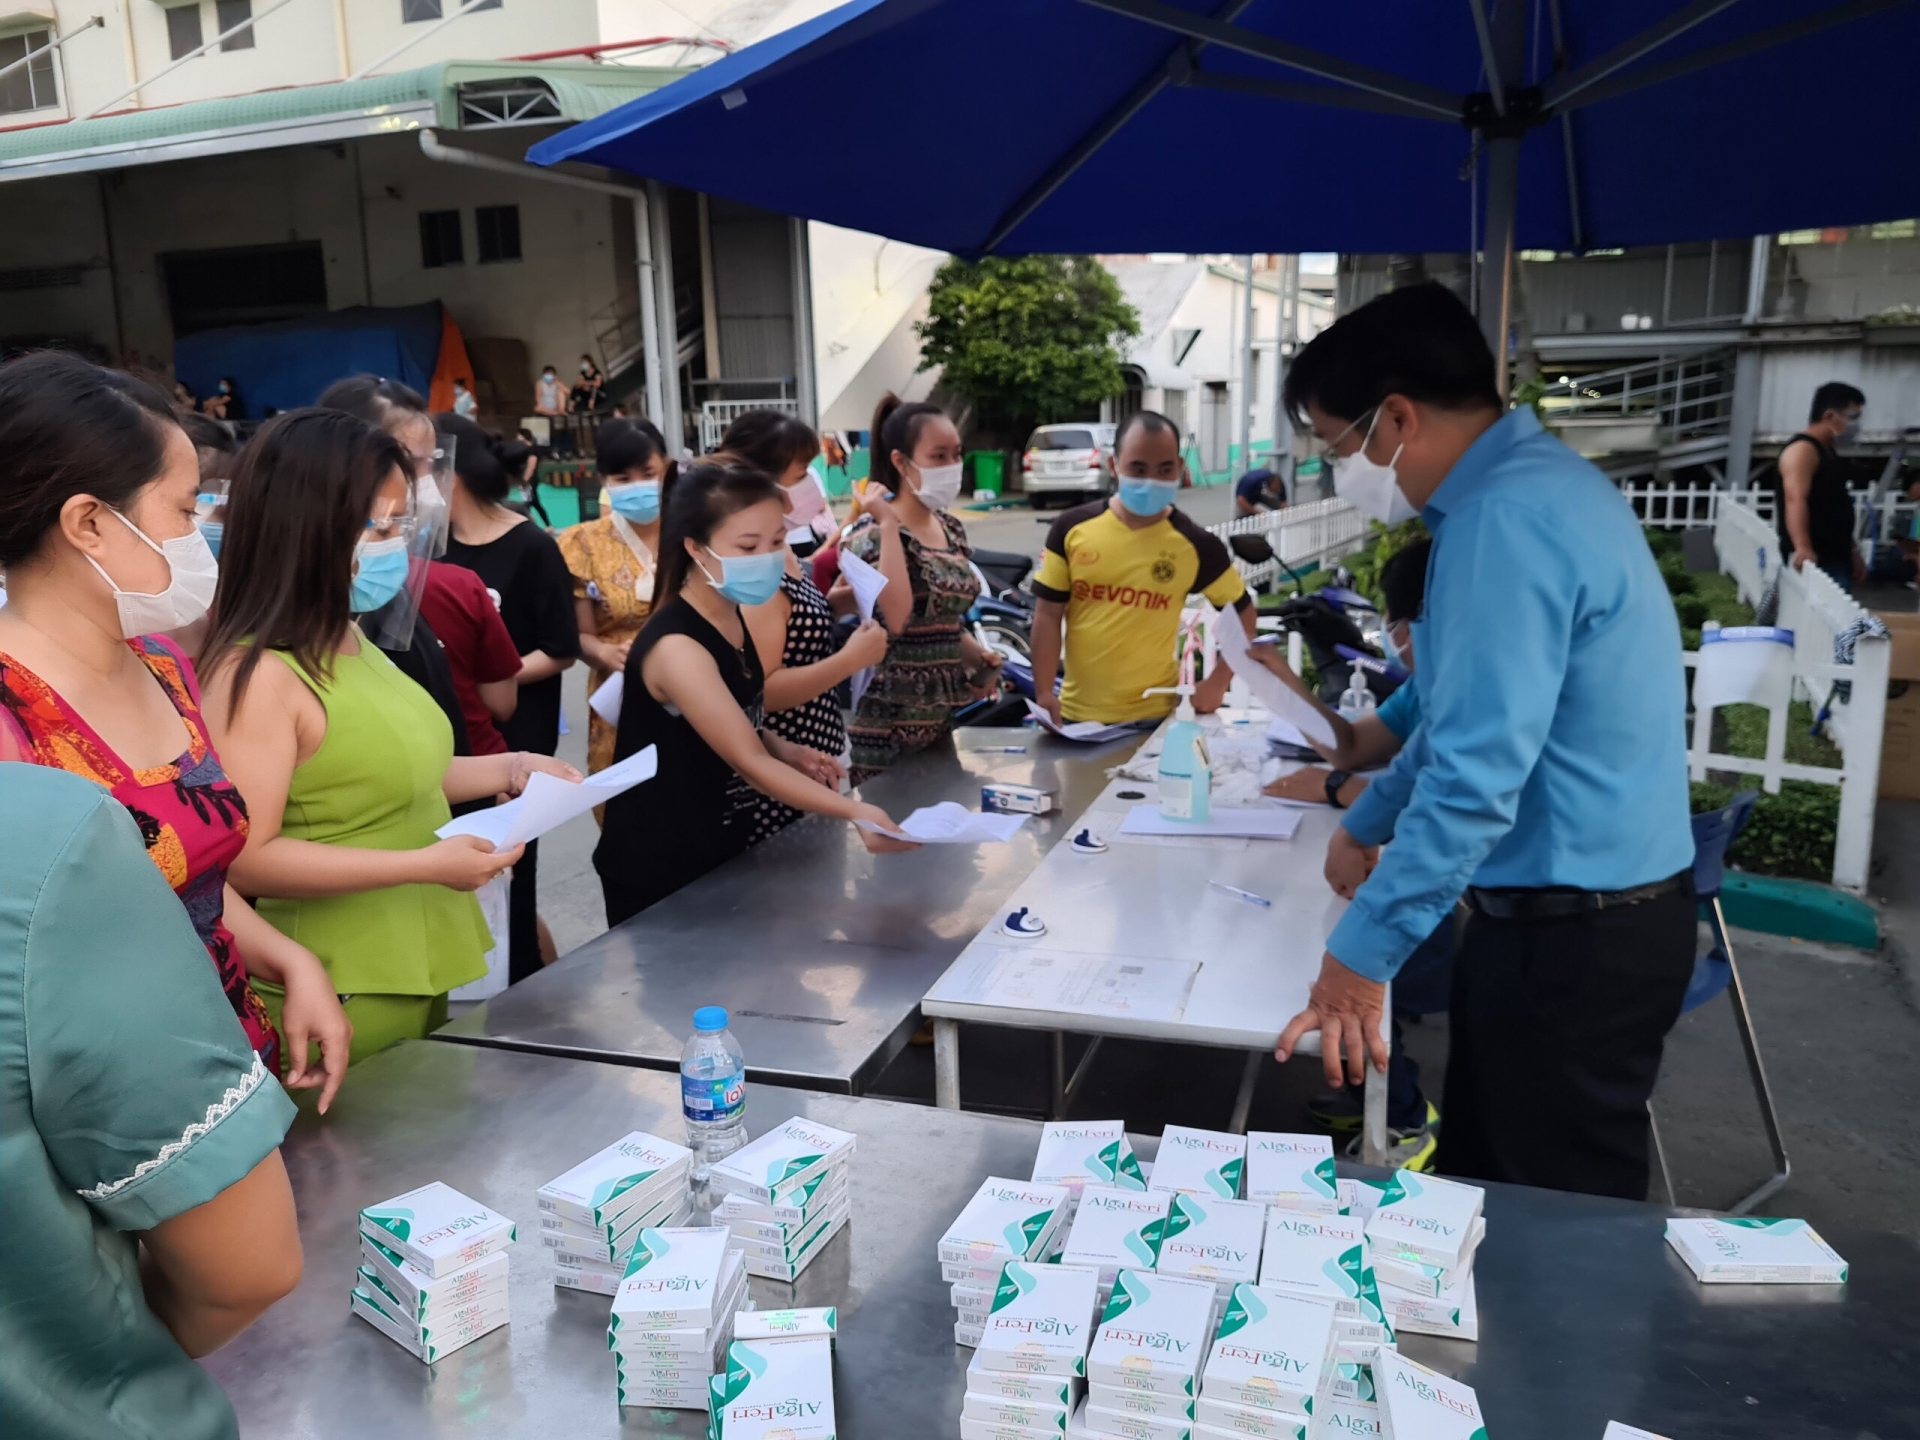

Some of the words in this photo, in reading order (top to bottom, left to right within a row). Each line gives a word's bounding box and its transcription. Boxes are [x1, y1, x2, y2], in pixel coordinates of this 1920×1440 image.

[1092, 584, 1171, 611] EVONIK
[779, 1125, 835, 1149] AlgaFeri
[1049, 1129, 1115, 1140] AlgaFeri
[1170, 1136, 1238, 1153] AlgaFeri
[613, 1141, 669, 1165] AlgaFeri
[1257, 1141, 1326, 1154] AlgaFeri
[983, 1187, 1054, 1205] AlgaFeri
[1088, 1196, 1161, 1212] AlgaFeri
[419, 1212, 488, 1247] AlgaFeri
[1277, 1220, 1355, 1239] AlgaFeri
[1380, 1211, 1456, 1237] AlgaFeri
[1169, 1244, 1247, 1262] AlgaFeri
[627, 1275, 708, 1293] AlgaFeri
[995, 1317, 1078, 1336] AlgaFeri
[1104, 1330, 1191, 1353] AlgaFeri
[1219, 1347, 1310, 1373] AlgaFeri
[1396, 1370, 1475, 1417] AlgaFeri
[733, 1398, 822, 1422] AlgaFeri
